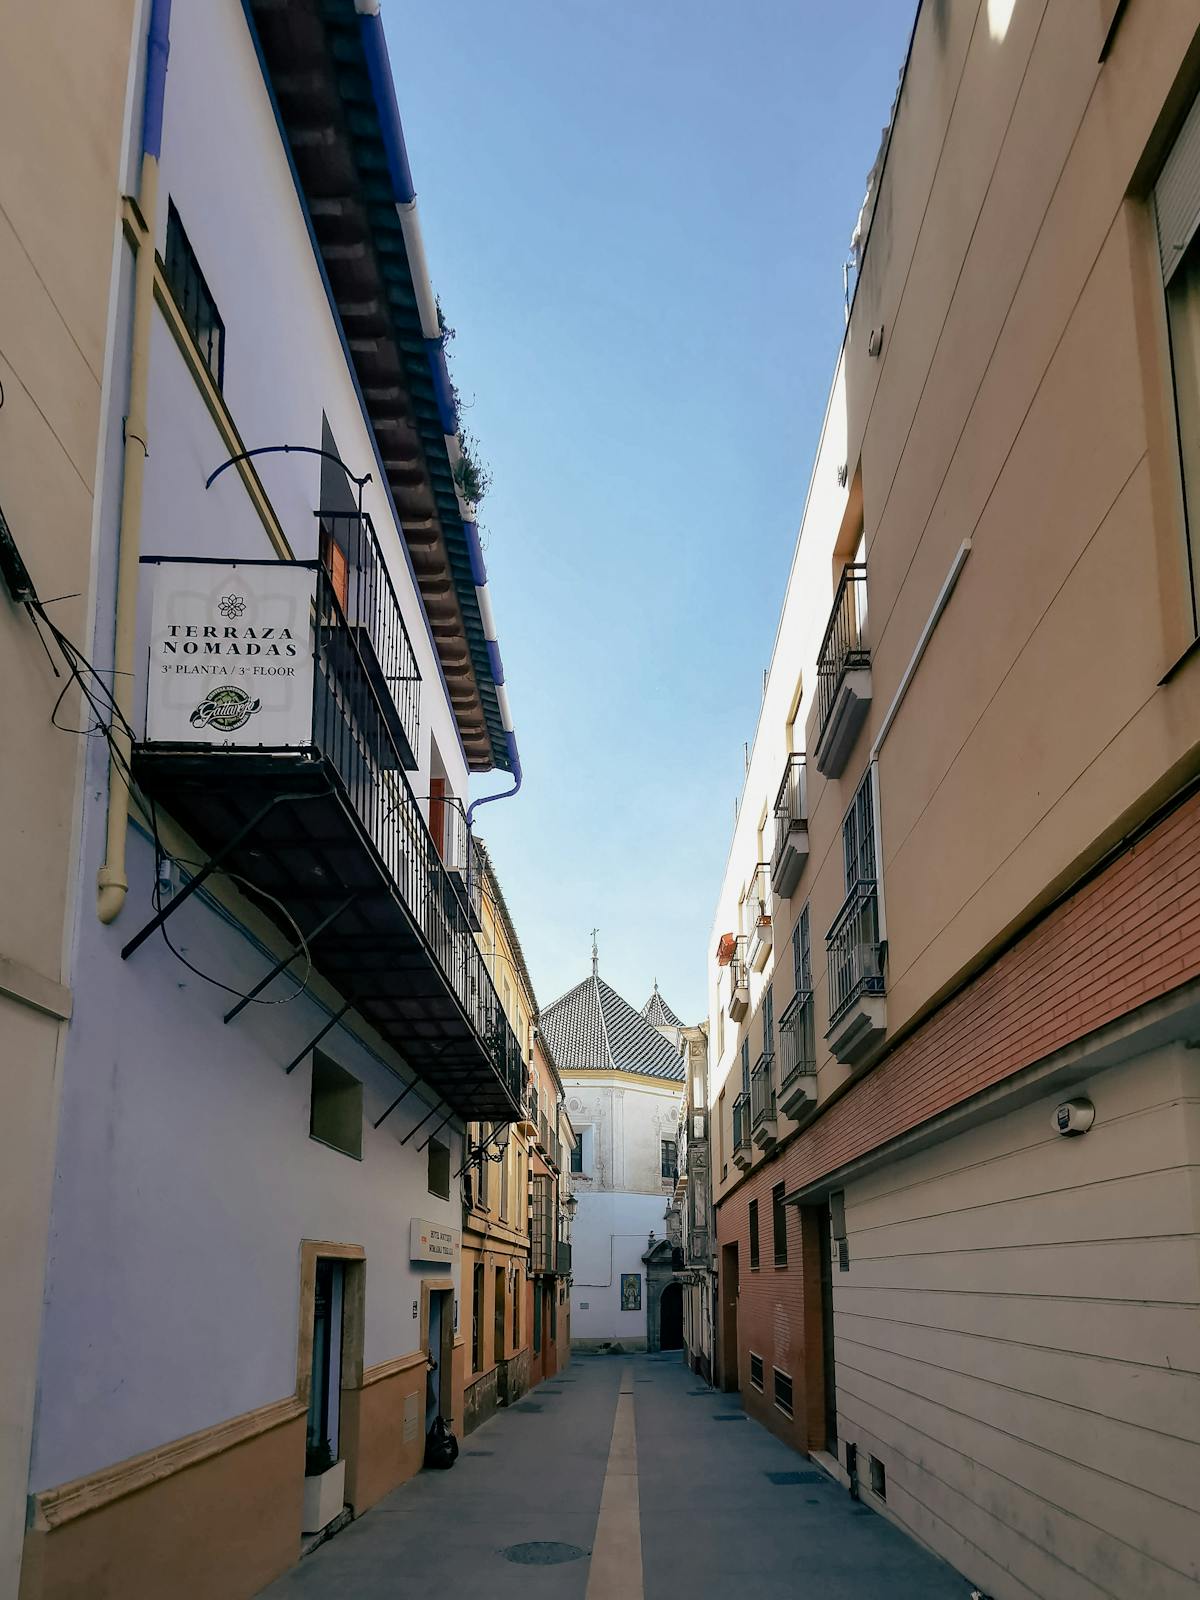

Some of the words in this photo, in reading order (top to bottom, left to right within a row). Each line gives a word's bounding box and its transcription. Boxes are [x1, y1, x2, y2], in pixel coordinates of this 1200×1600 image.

[167, 625, 293, 640] TERRAZA
[162, 641, 297, 657] NOMADAS
[176, 664, 228, 675] PLANTA
[230, 665, 236, 675] /
[253, 666, 296, 677] FLOOR
